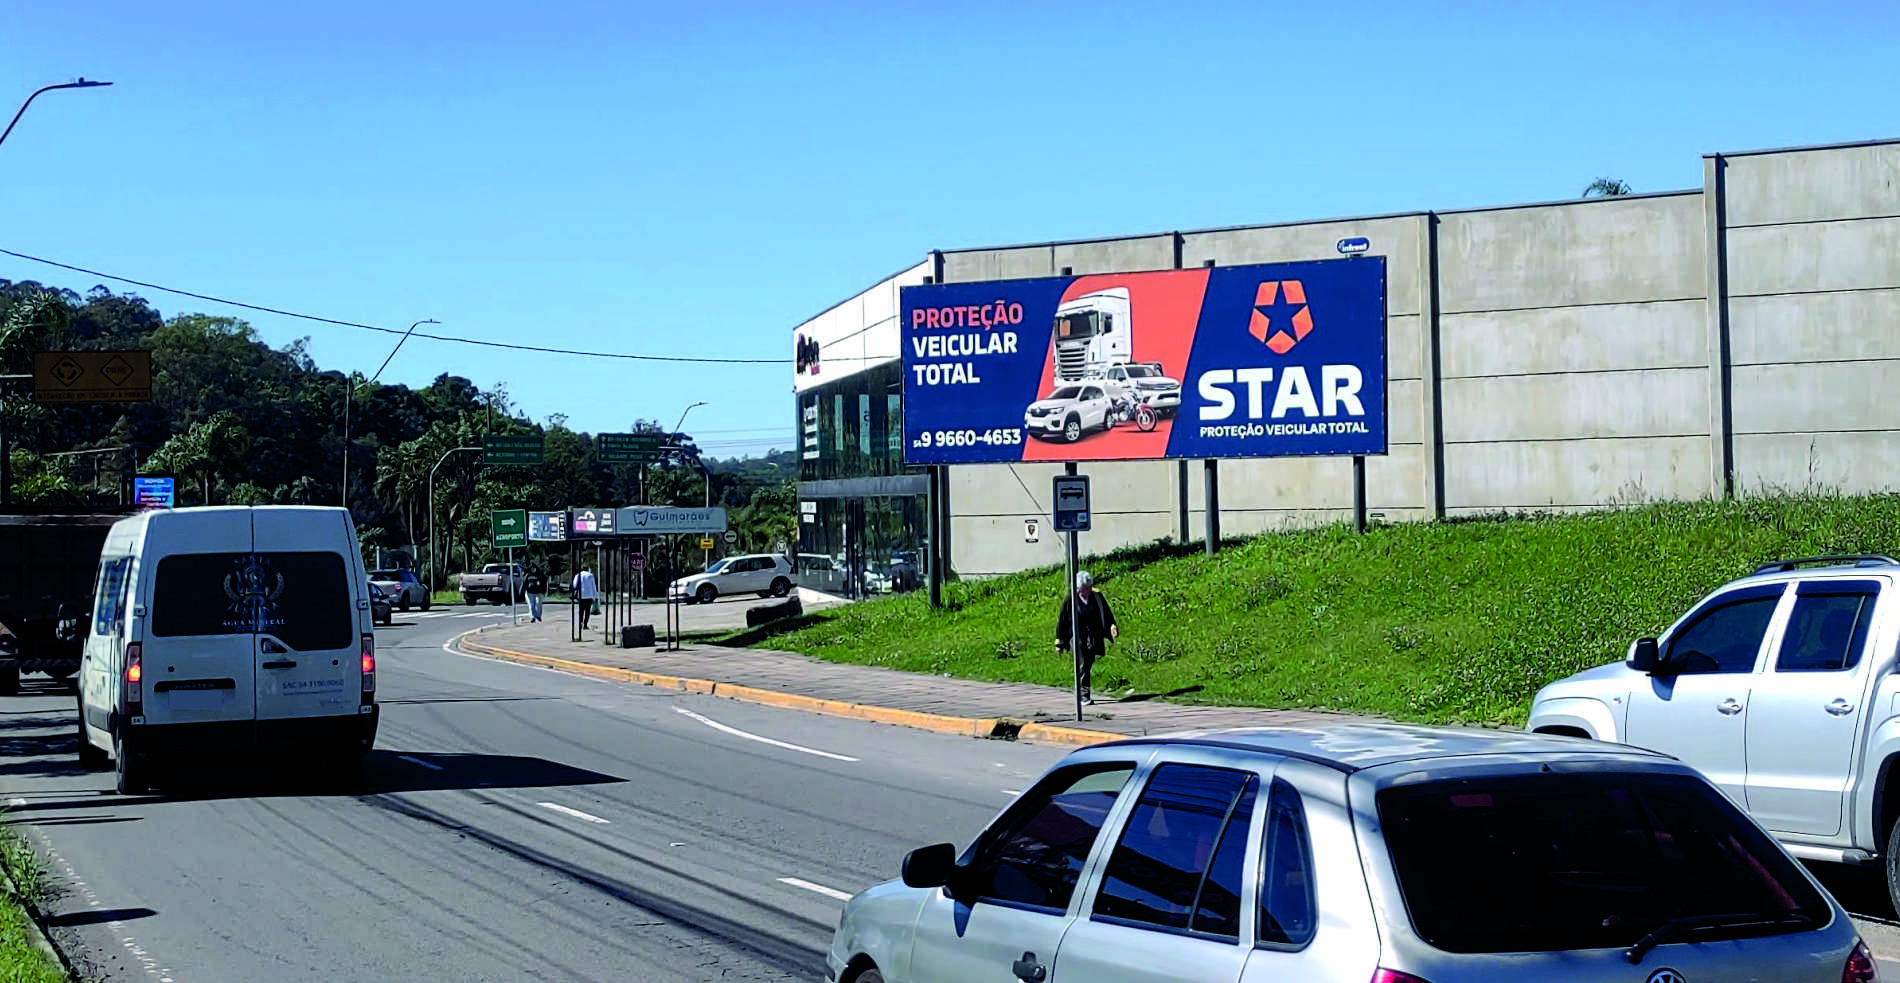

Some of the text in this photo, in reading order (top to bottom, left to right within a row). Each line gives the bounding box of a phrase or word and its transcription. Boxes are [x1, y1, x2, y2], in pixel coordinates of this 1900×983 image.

[912, 300, 1024, 331] PROTEÇÃO
[912, 332, 1018, 358] VEICULAR
[913, 361, 981, 386] TOTAL
[1198, 364, 1366, 421] STAR
[935, 428, 1022, 447] 9660-4653
[1199, 421, 1369, 439] PROTEÇÃO VEICULAR TOTAL
[495, 533, 524, 541] AEROPORTO
[247, 617, 286, 626] MIERAL
